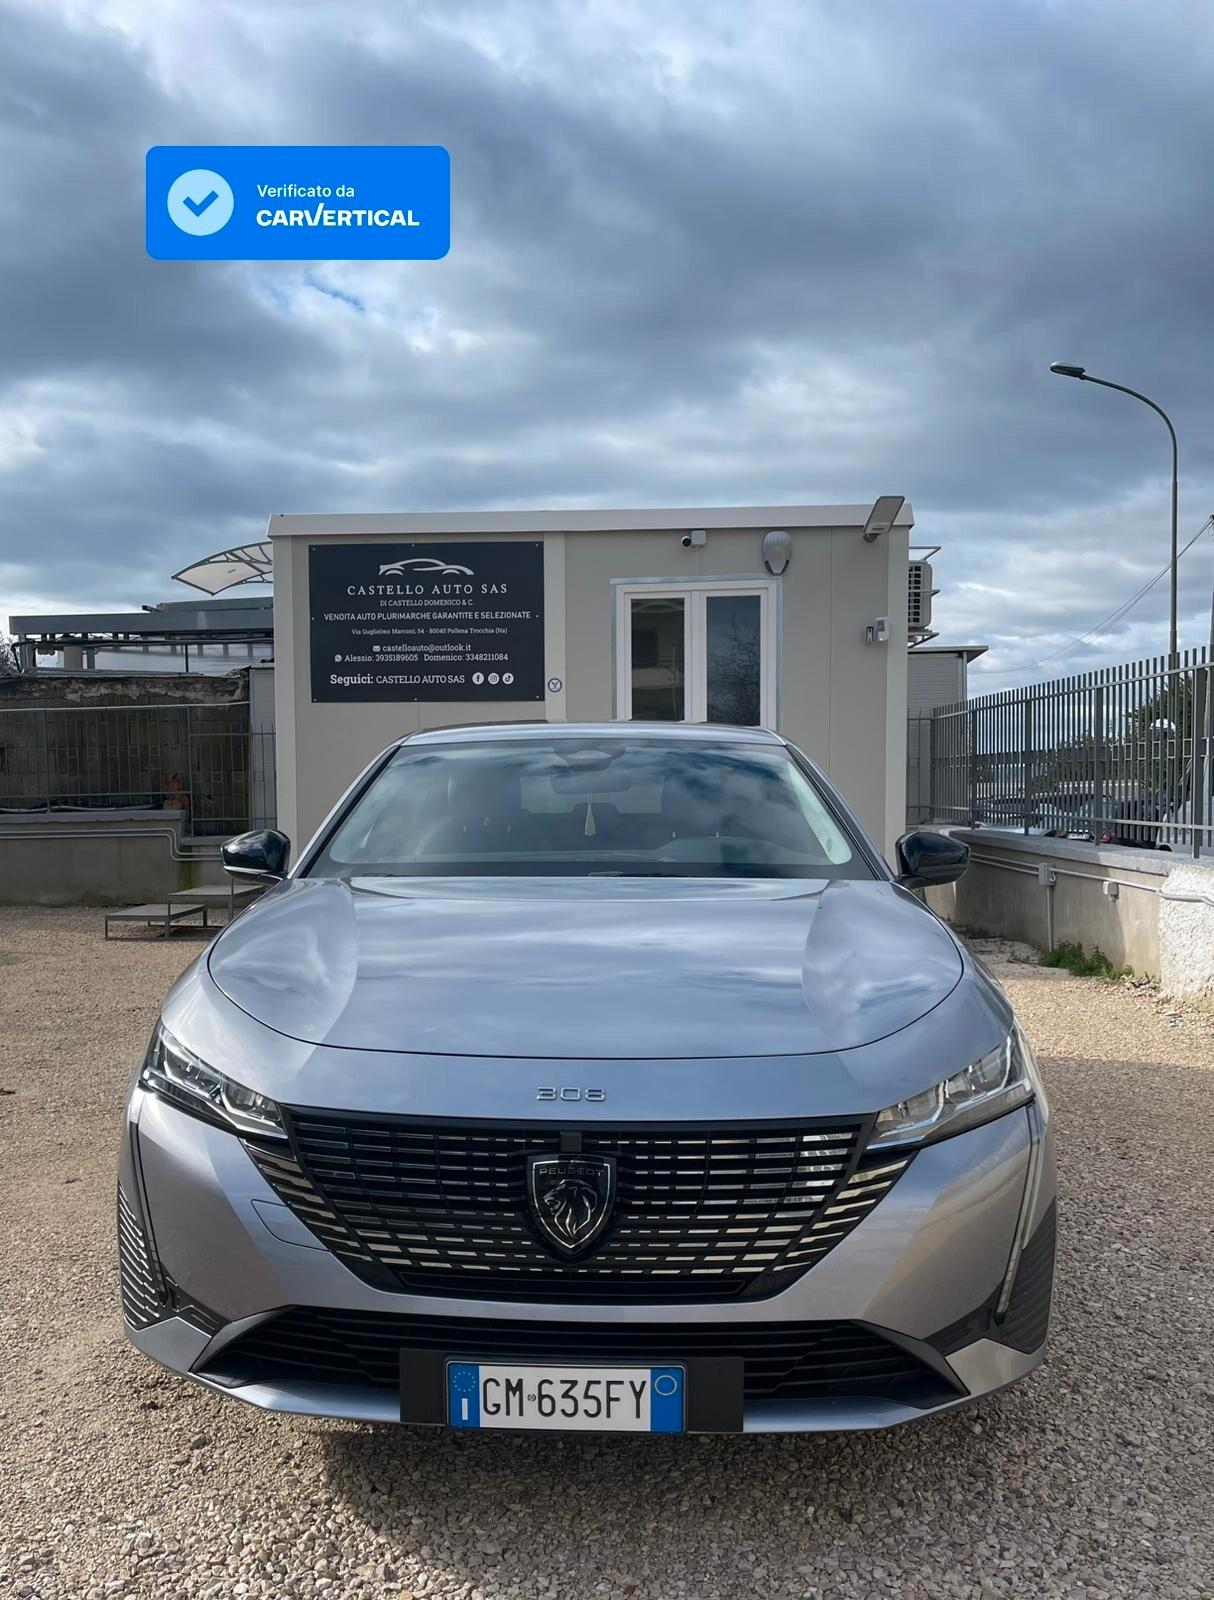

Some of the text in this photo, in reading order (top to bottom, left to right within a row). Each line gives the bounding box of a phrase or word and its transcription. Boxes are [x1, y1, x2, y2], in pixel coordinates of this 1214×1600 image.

[347, 583, 507, 596] CASTELLO AUTO SAS
[324, 613, 356, 621] VENDITA
[377, 612, 431, 620] PLURIMARCHE
[480, 611, 531, 619] SELEZIONATE
[361, 628, 391, 636] Guglielmo
[382, 644, 472, 653] castelloauto@outlook.it
[344, 654, 373, 662] Alessio:
[375, 654, 419, 662] 3935189605
[465, 653, 508, 661] 3348211084
[330, 673, 465, 686] Seguici: CASTELLO AUTO SAS
[536, 1087, 606, 1102] 308
[539, 1167, 605, 1176] PEUGEOT
